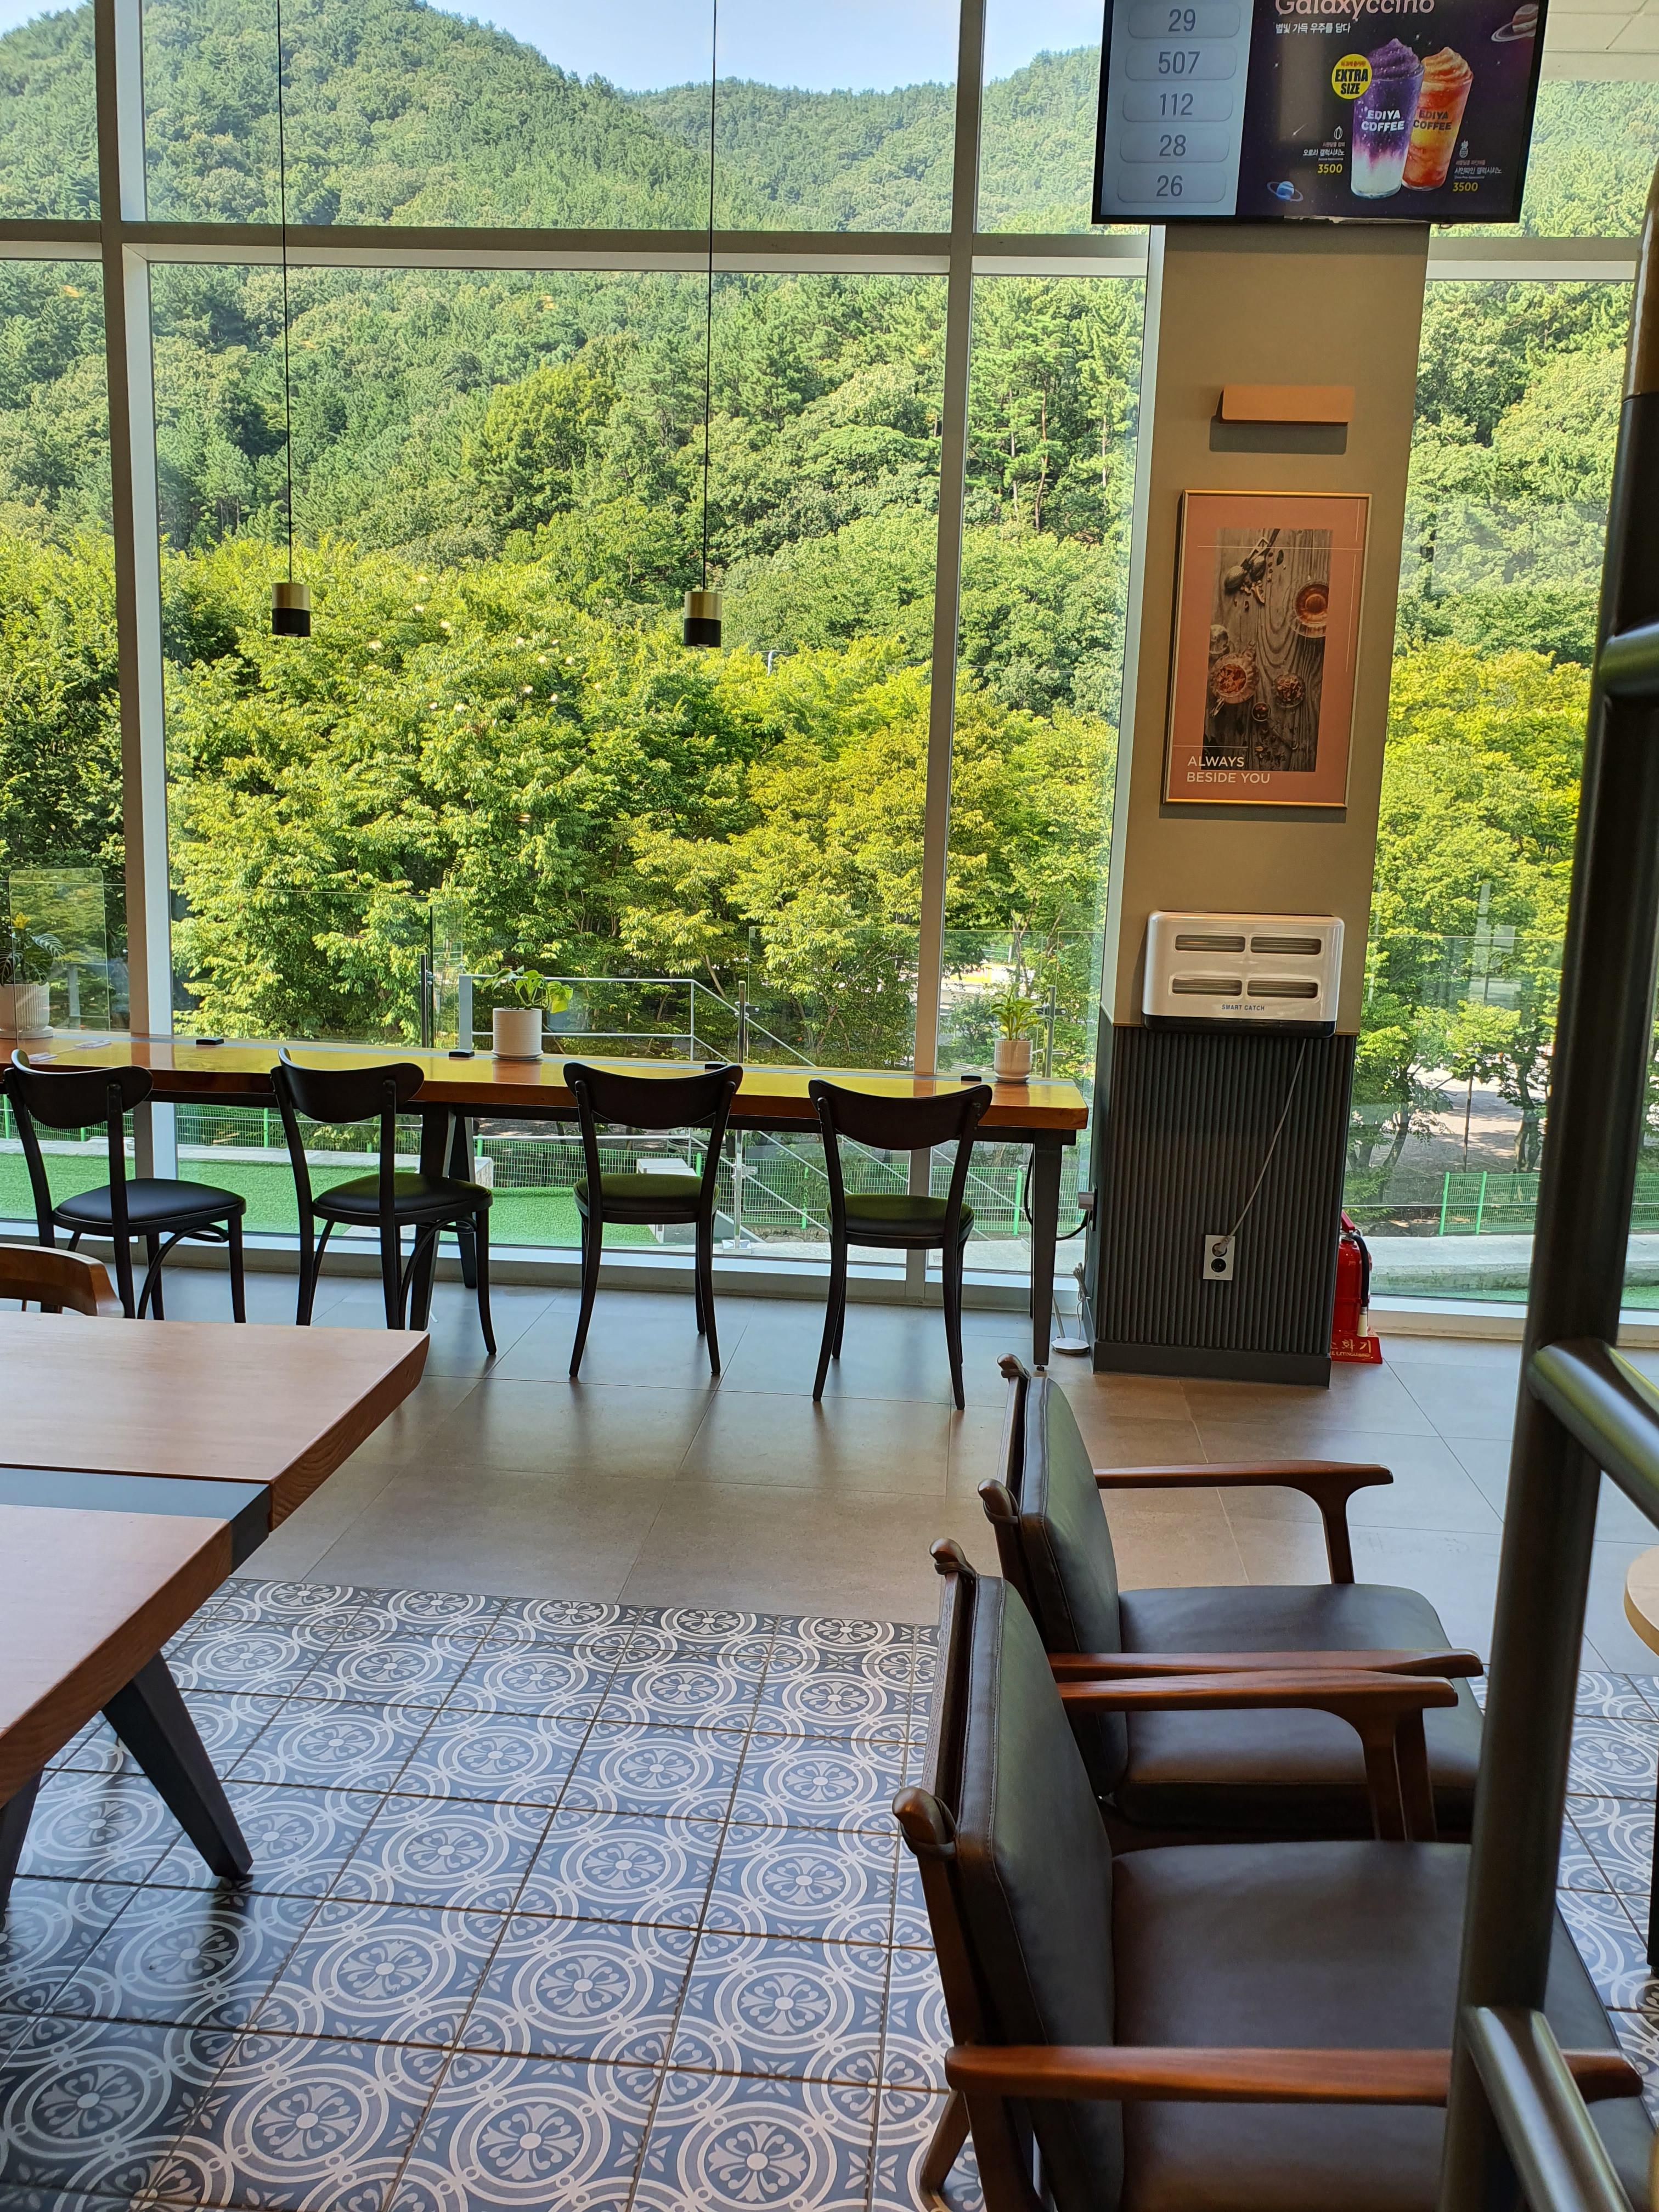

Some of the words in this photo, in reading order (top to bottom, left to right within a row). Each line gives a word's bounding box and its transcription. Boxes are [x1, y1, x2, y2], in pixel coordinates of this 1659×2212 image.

[1168, 9, 1196, 32] 29
[1276, 22, 1290, 33] 별빛
[1292, 22, 1308, 33] 가득
[1310, 23, 1333, 33] 우주를
[1335, 22, 1351, 33] 담다
[1158, 51, 1200, 74] 507
[1335, 69, 1368, 82] EXTRA
[1340, 83, 1361, 94] SIZE
[1160, 93, 1193, 116] 112
[1365, 110, 1401, 121] EDIYA
[1419, 111, 1448, 120] EDIYA
[1361, 121, 1405, 132] COFFEE
[1413, 120, 1452, 131] COFFEE
[1159, 134, 1187, 156] 28
[1317, 163, 1343, 173] 3500
[1156, 175, 1183, 197] 26
[1452, 182, 1479, 191] 3500
[1187, 755, 1245, 768] ALWAYS
[1187, 772, 1236, 783] BESIDE
[1241, 772, 1270, 784] YOU
